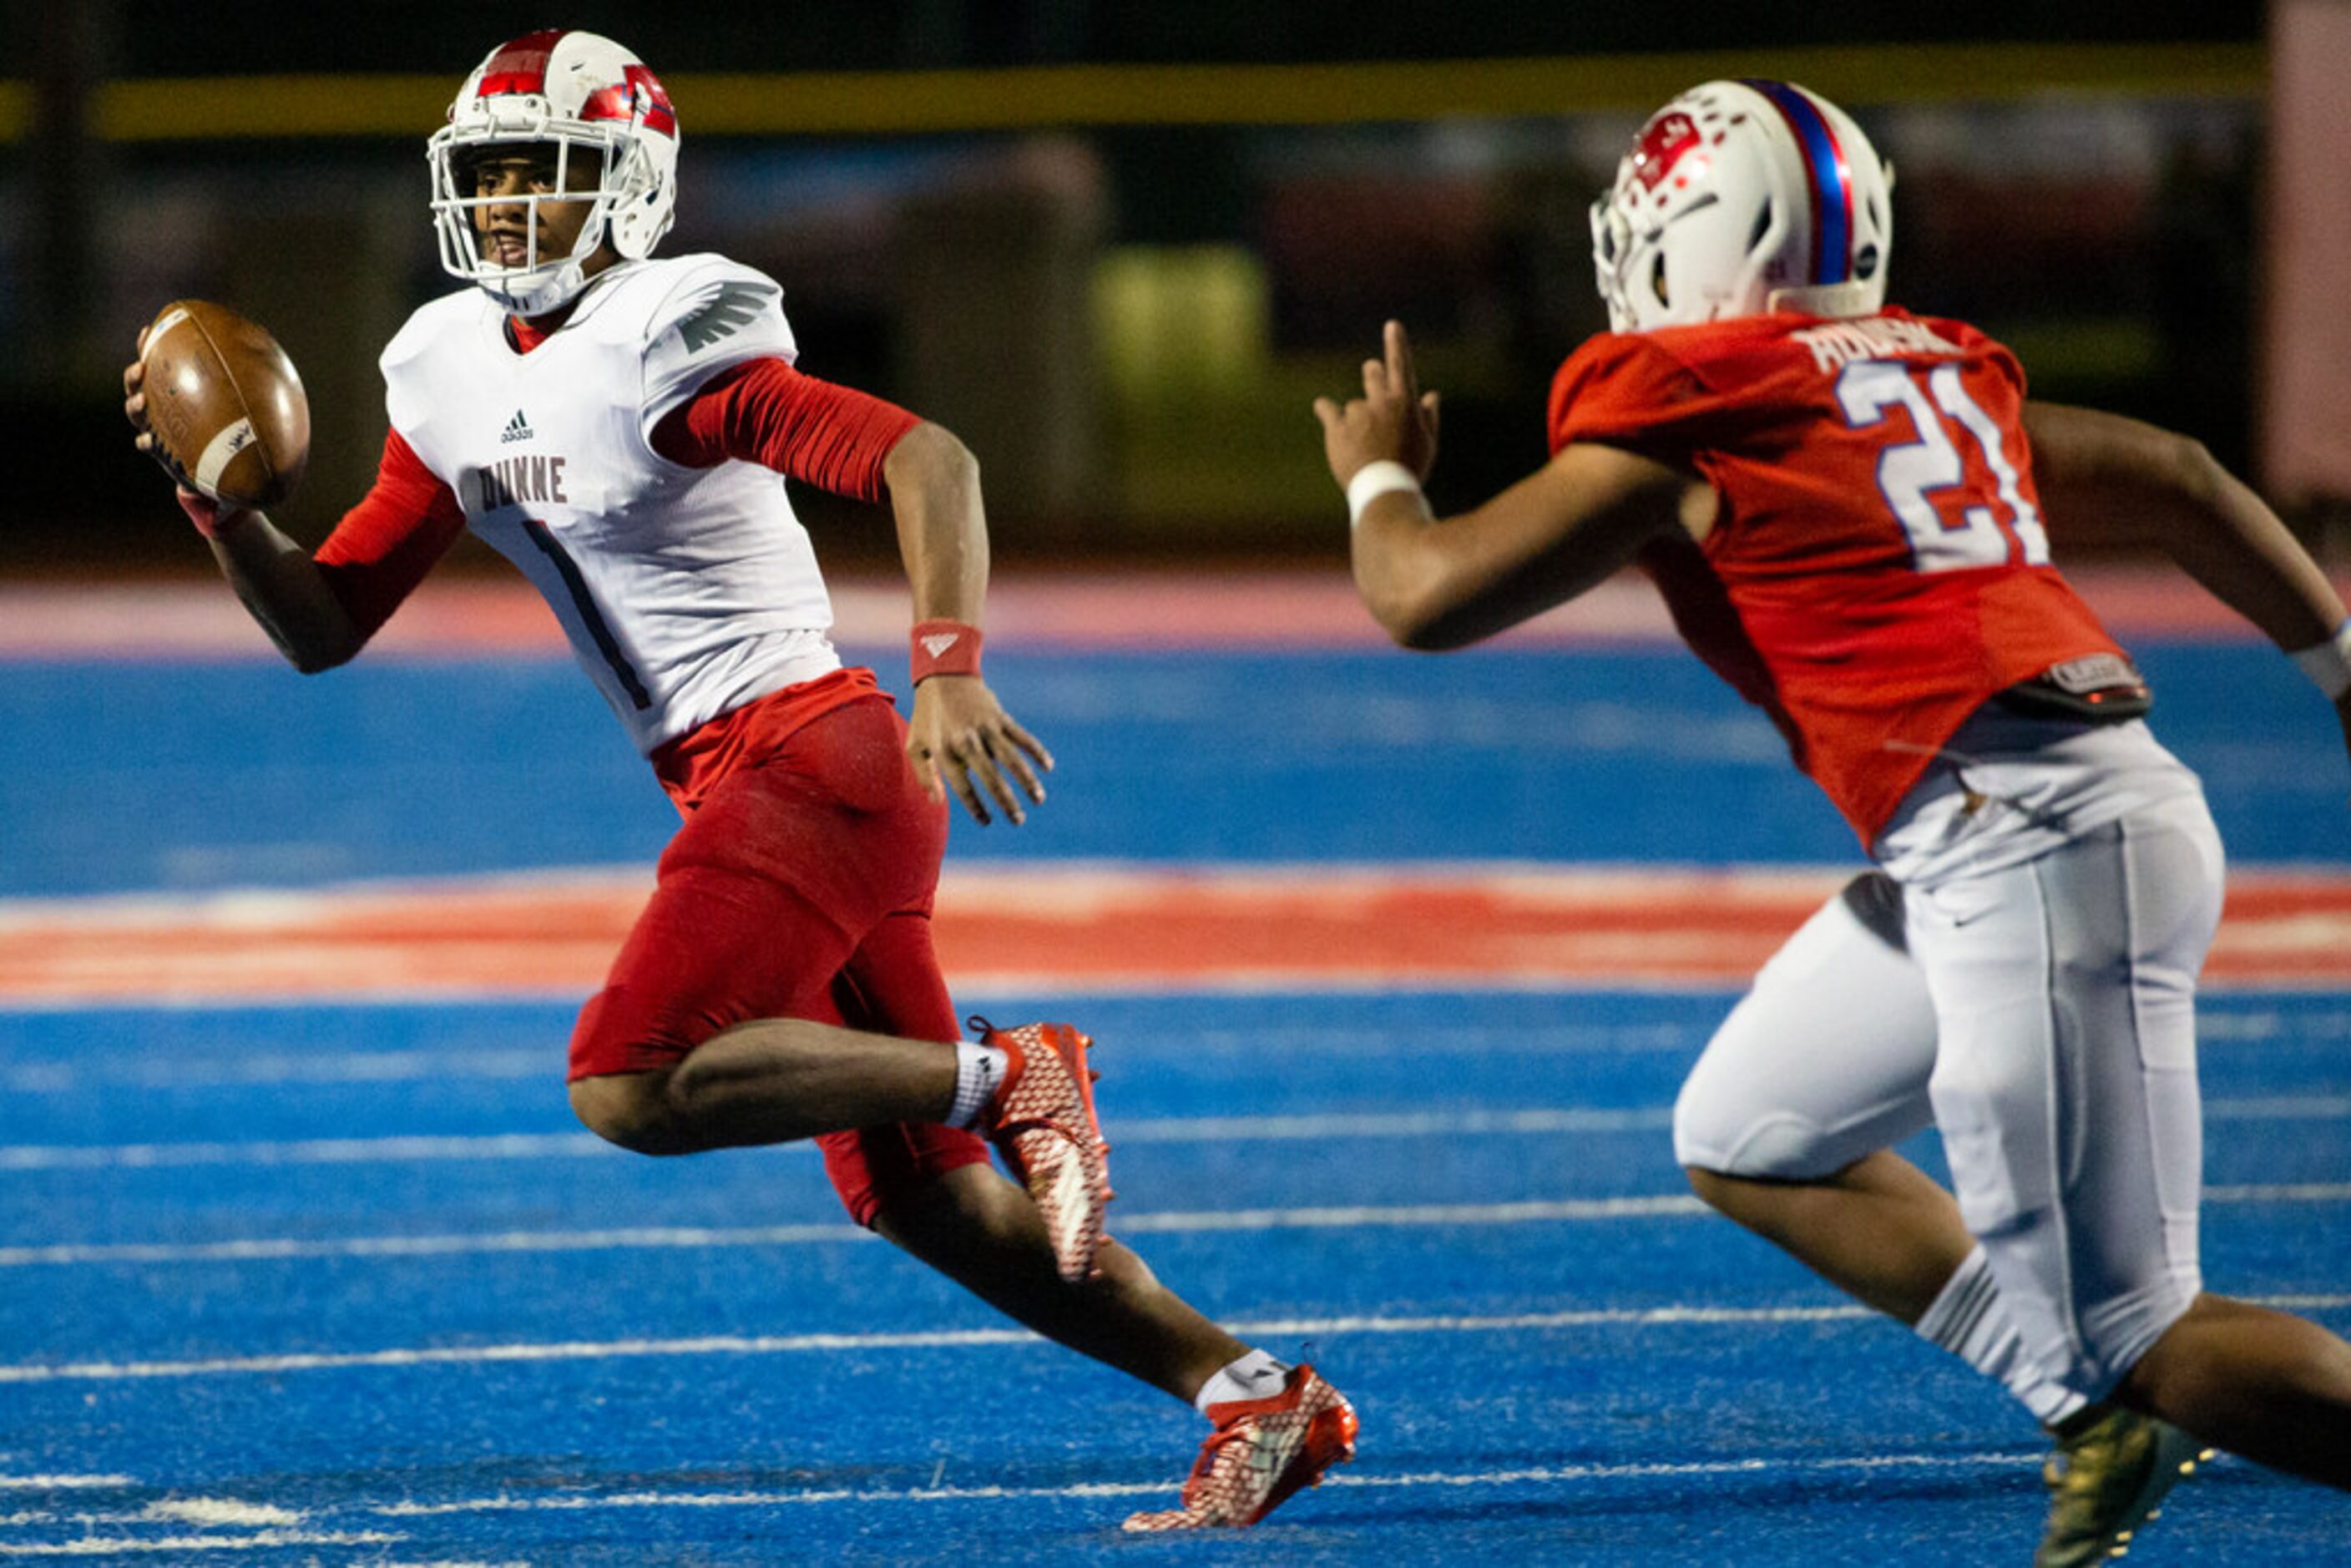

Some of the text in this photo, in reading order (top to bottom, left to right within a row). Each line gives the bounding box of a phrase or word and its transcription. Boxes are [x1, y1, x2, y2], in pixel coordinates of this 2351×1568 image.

[478, 456, 568, 513] DUNNE
[501, 428, 533, 443] adidas
[1835, 360, 2050, 574] 21
[522, 519, 652, 710] 1
